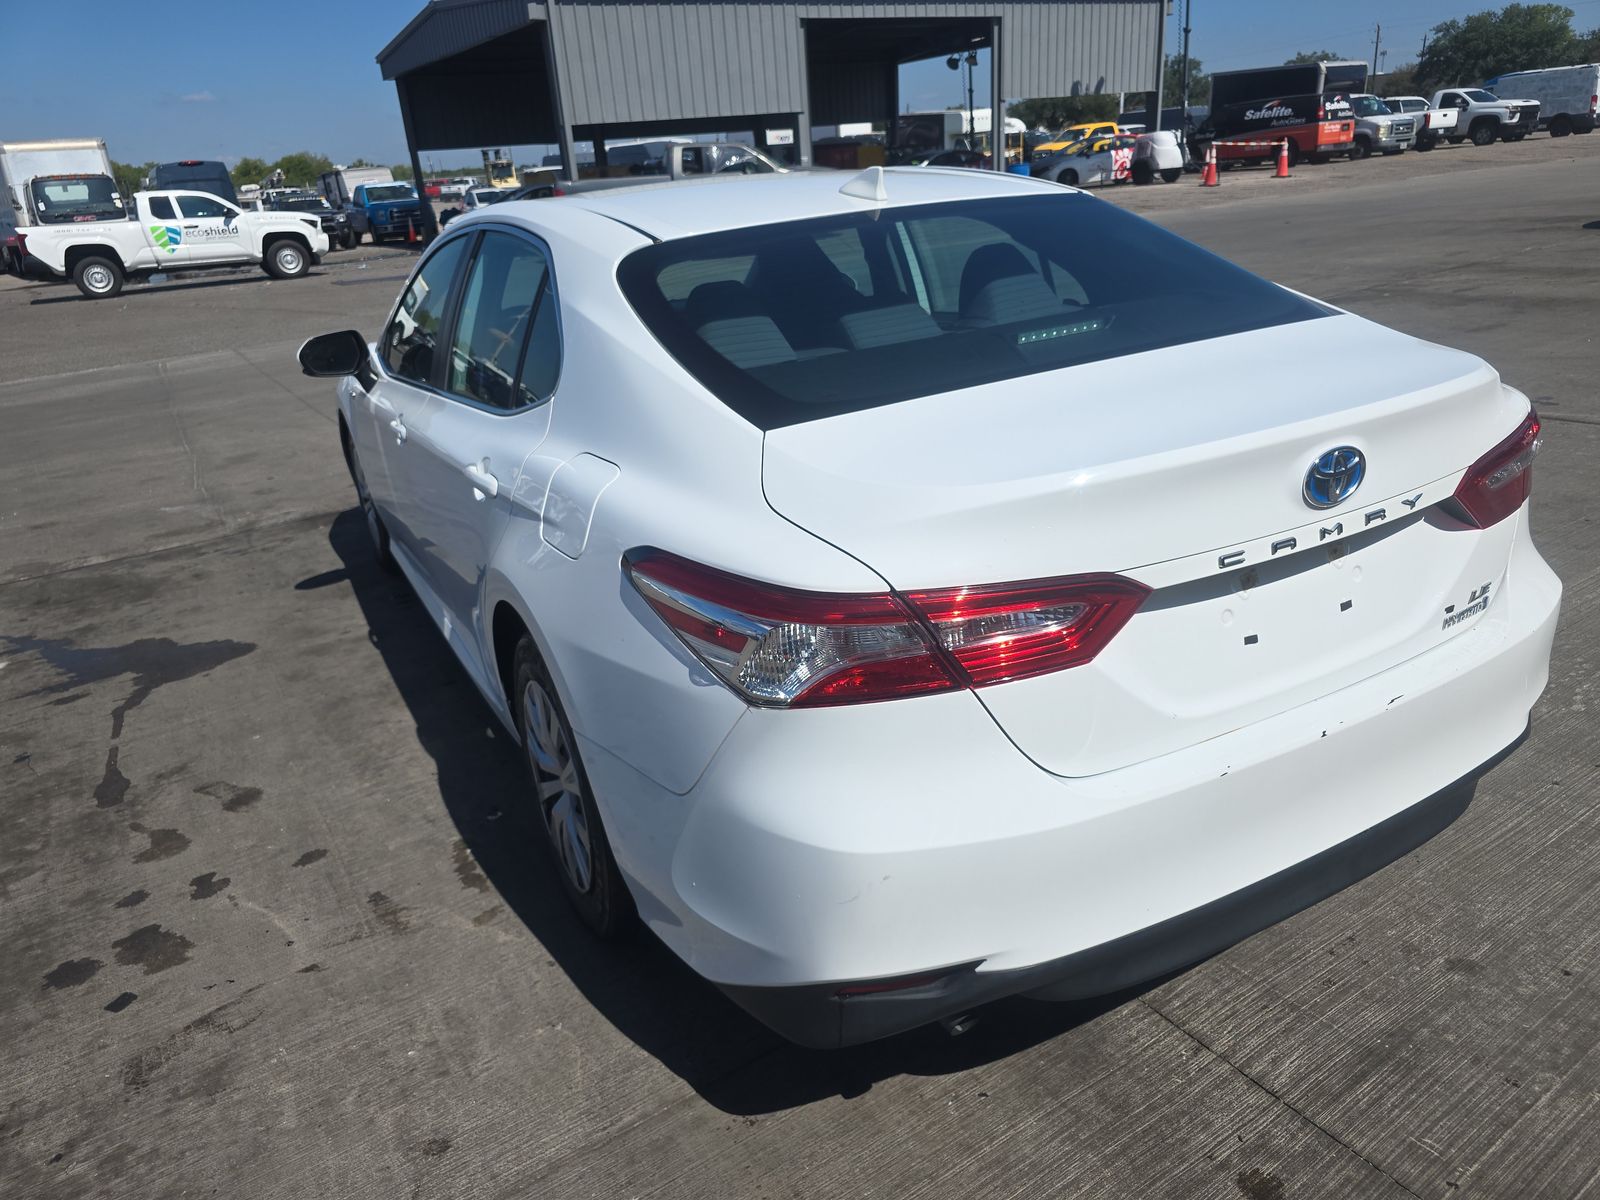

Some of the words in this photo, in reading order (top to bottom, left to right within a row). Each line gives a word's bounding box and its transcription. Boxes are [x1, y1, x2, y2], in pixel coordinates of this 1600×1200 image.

[1244, 106, 1292, 120] Safelite
[185, 225, 239, 237] ecoshield
[1218, 493, 1423, 569] CAMRY
[1468, 581, 1491, 604] LE
